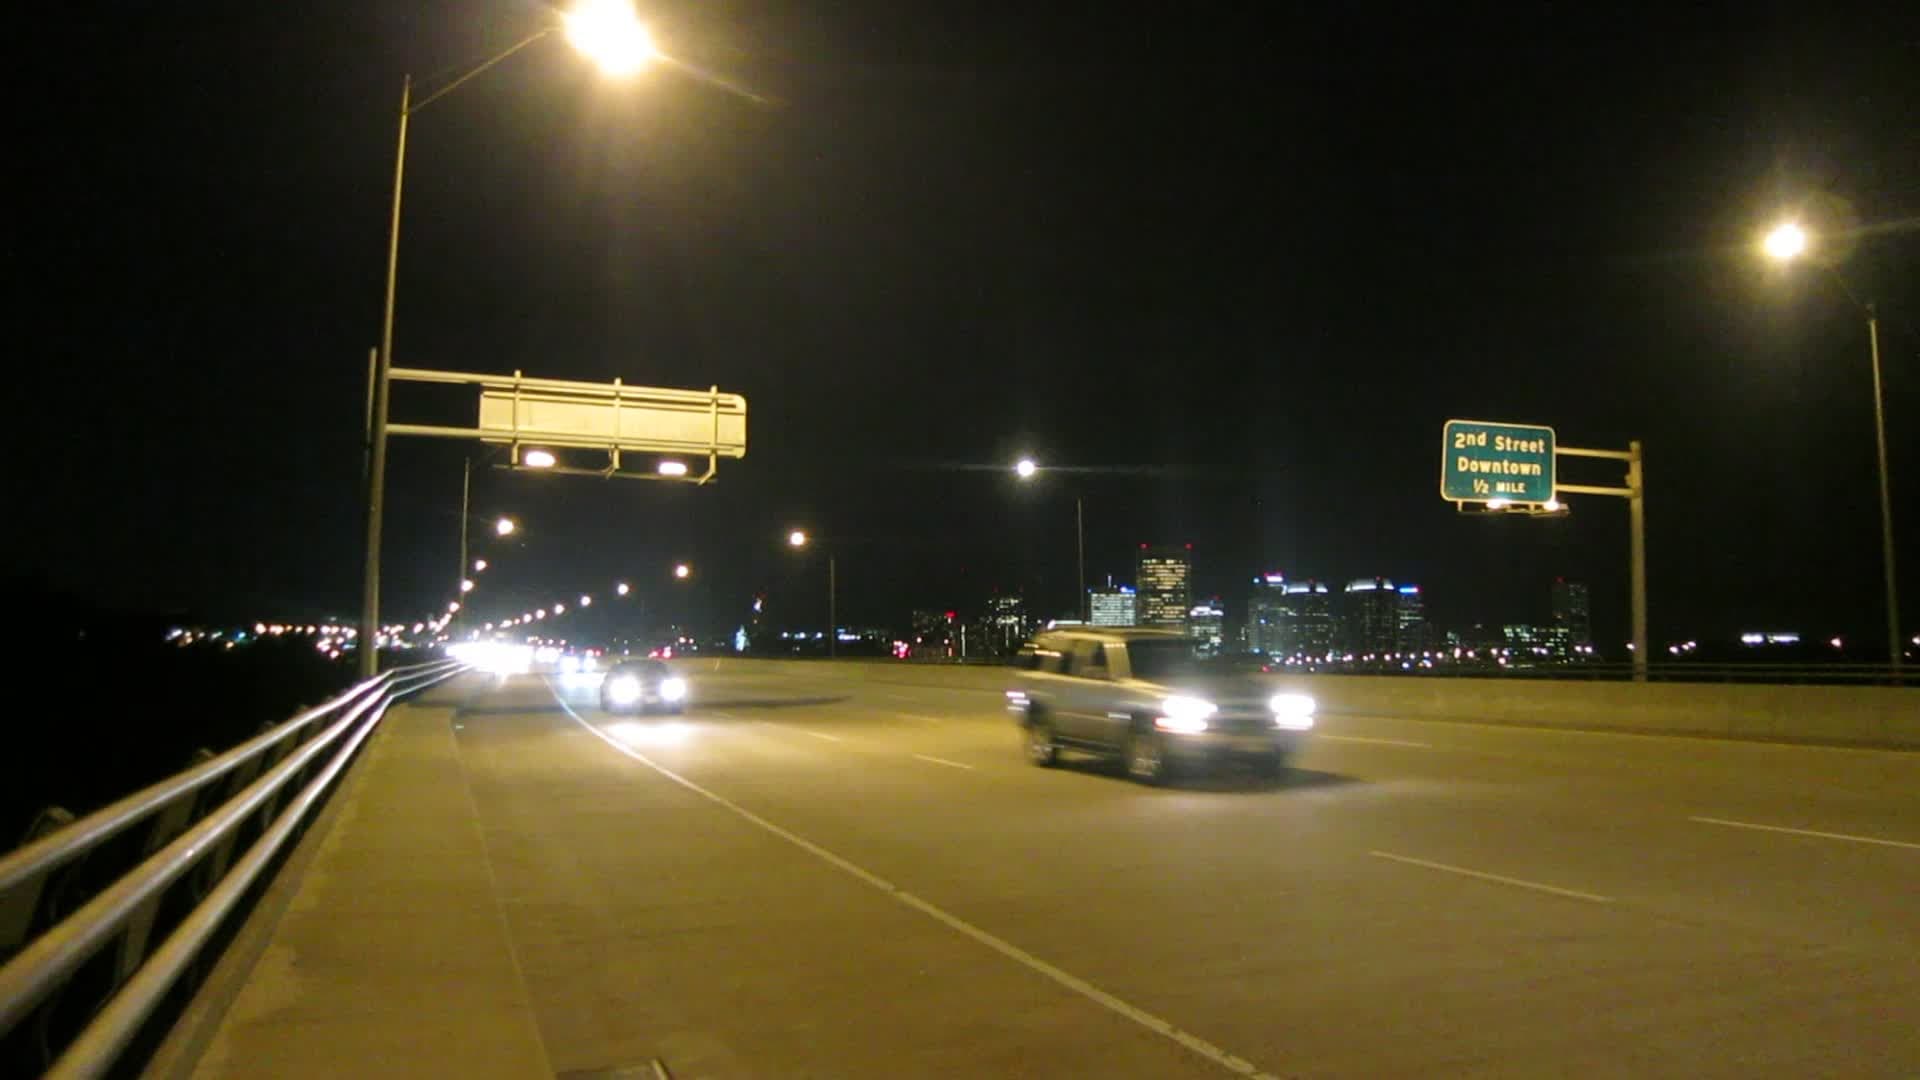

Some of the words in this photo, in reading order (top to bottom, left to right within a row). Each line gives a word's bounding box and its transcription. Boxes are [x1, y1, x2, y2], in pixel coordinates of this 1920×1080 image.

[1454, 432, 1487, 449] 2nd
[1495, 435, 1545, 454] Street
[1457, 456, 1541, 475] Downtown
[1496, 481, 1526, 493] MILE
